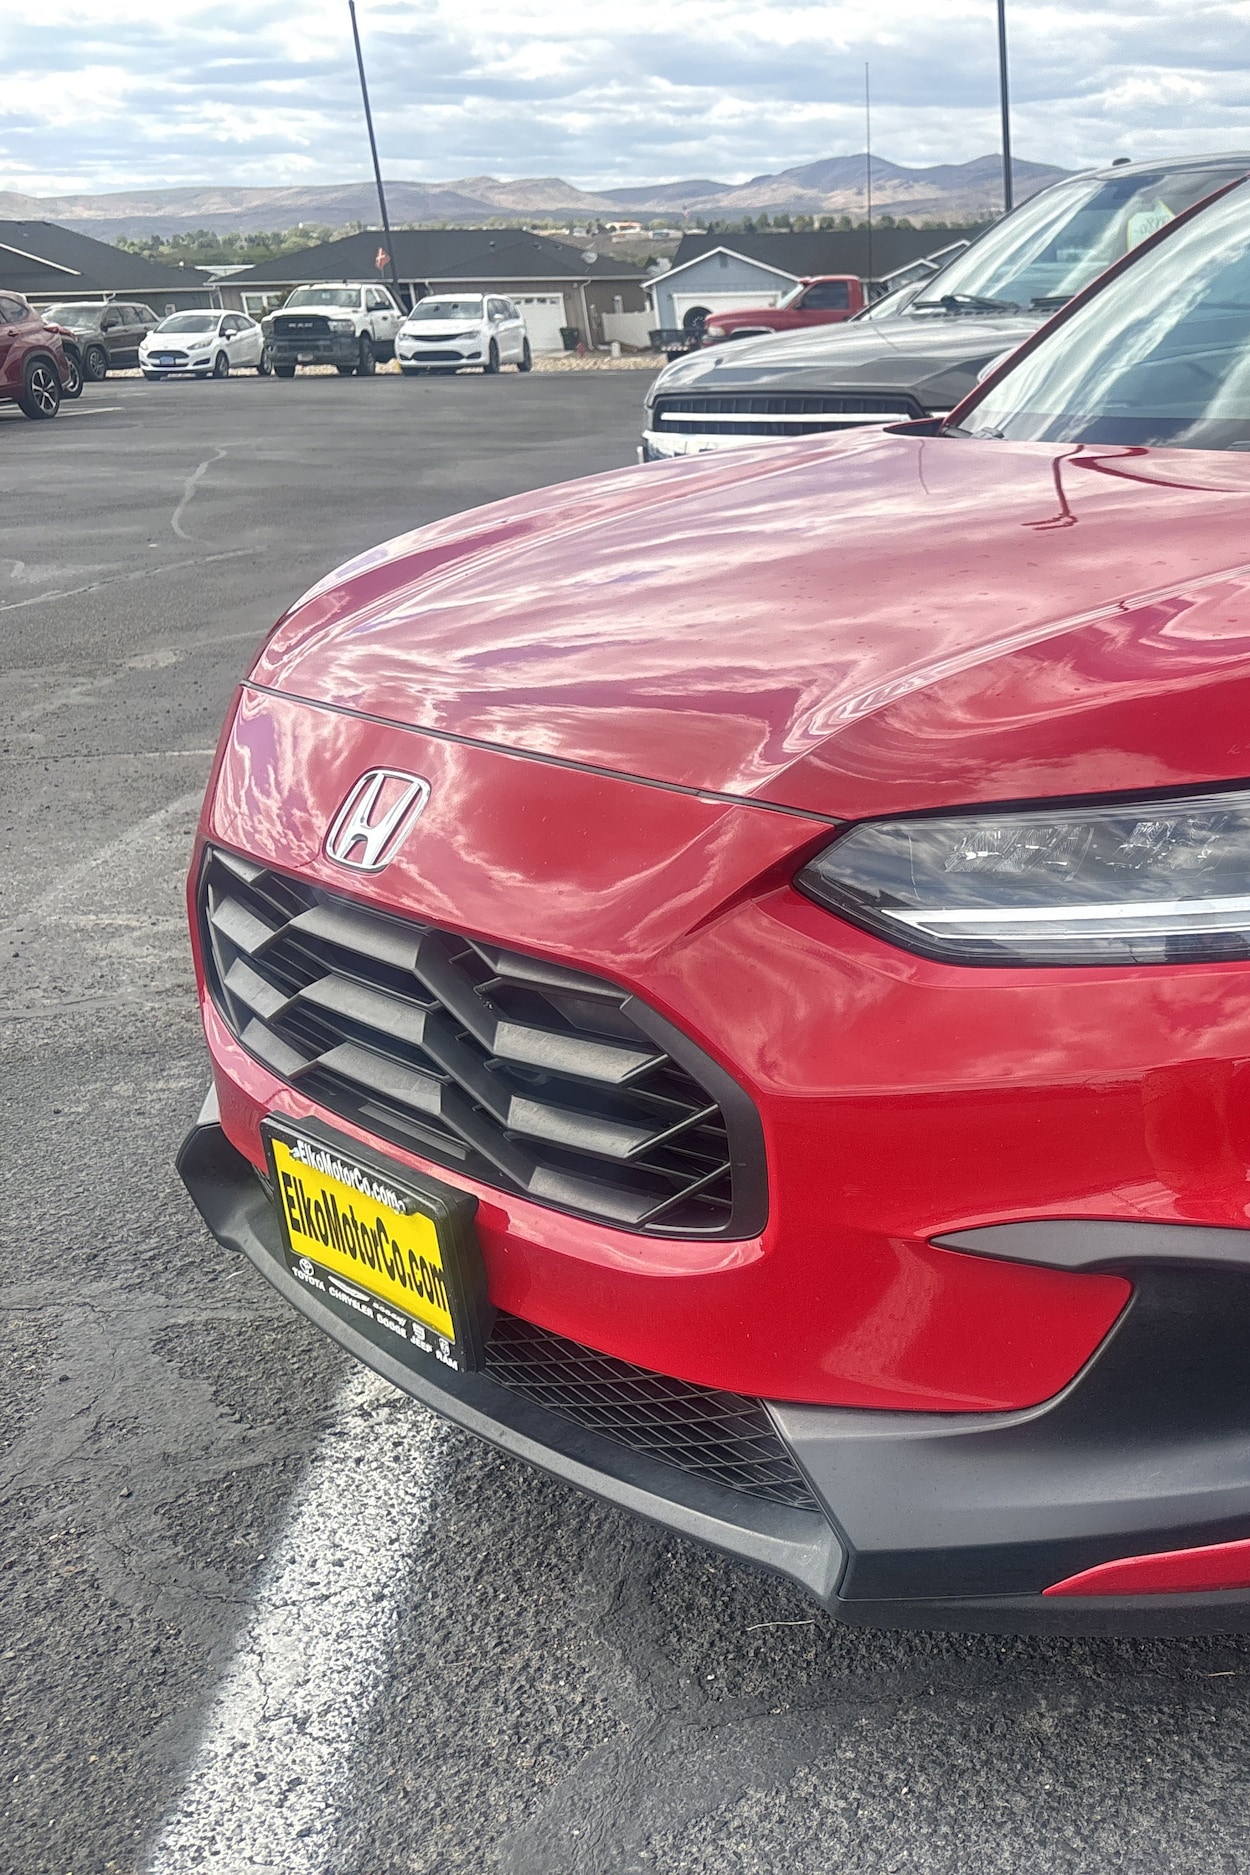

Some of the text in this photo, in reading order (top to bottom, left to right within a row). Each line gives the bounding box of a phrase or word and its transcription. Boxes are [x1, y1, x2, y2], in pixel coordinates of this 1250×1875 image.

[296, 1139, 400, 1212] ElkoMotorCo.com
[281, 1170, 449, 1313] ElkoMotorCo.com
[292, 1266, 325, 1292] TOYOTA
[328, 1286, 374, 1318] CHRYSLER
[376, 1313, 407, 1339] DODGE
[410, 1335, 433, 1354] JEEP
[435, 1350, 458, 1372] RAM
